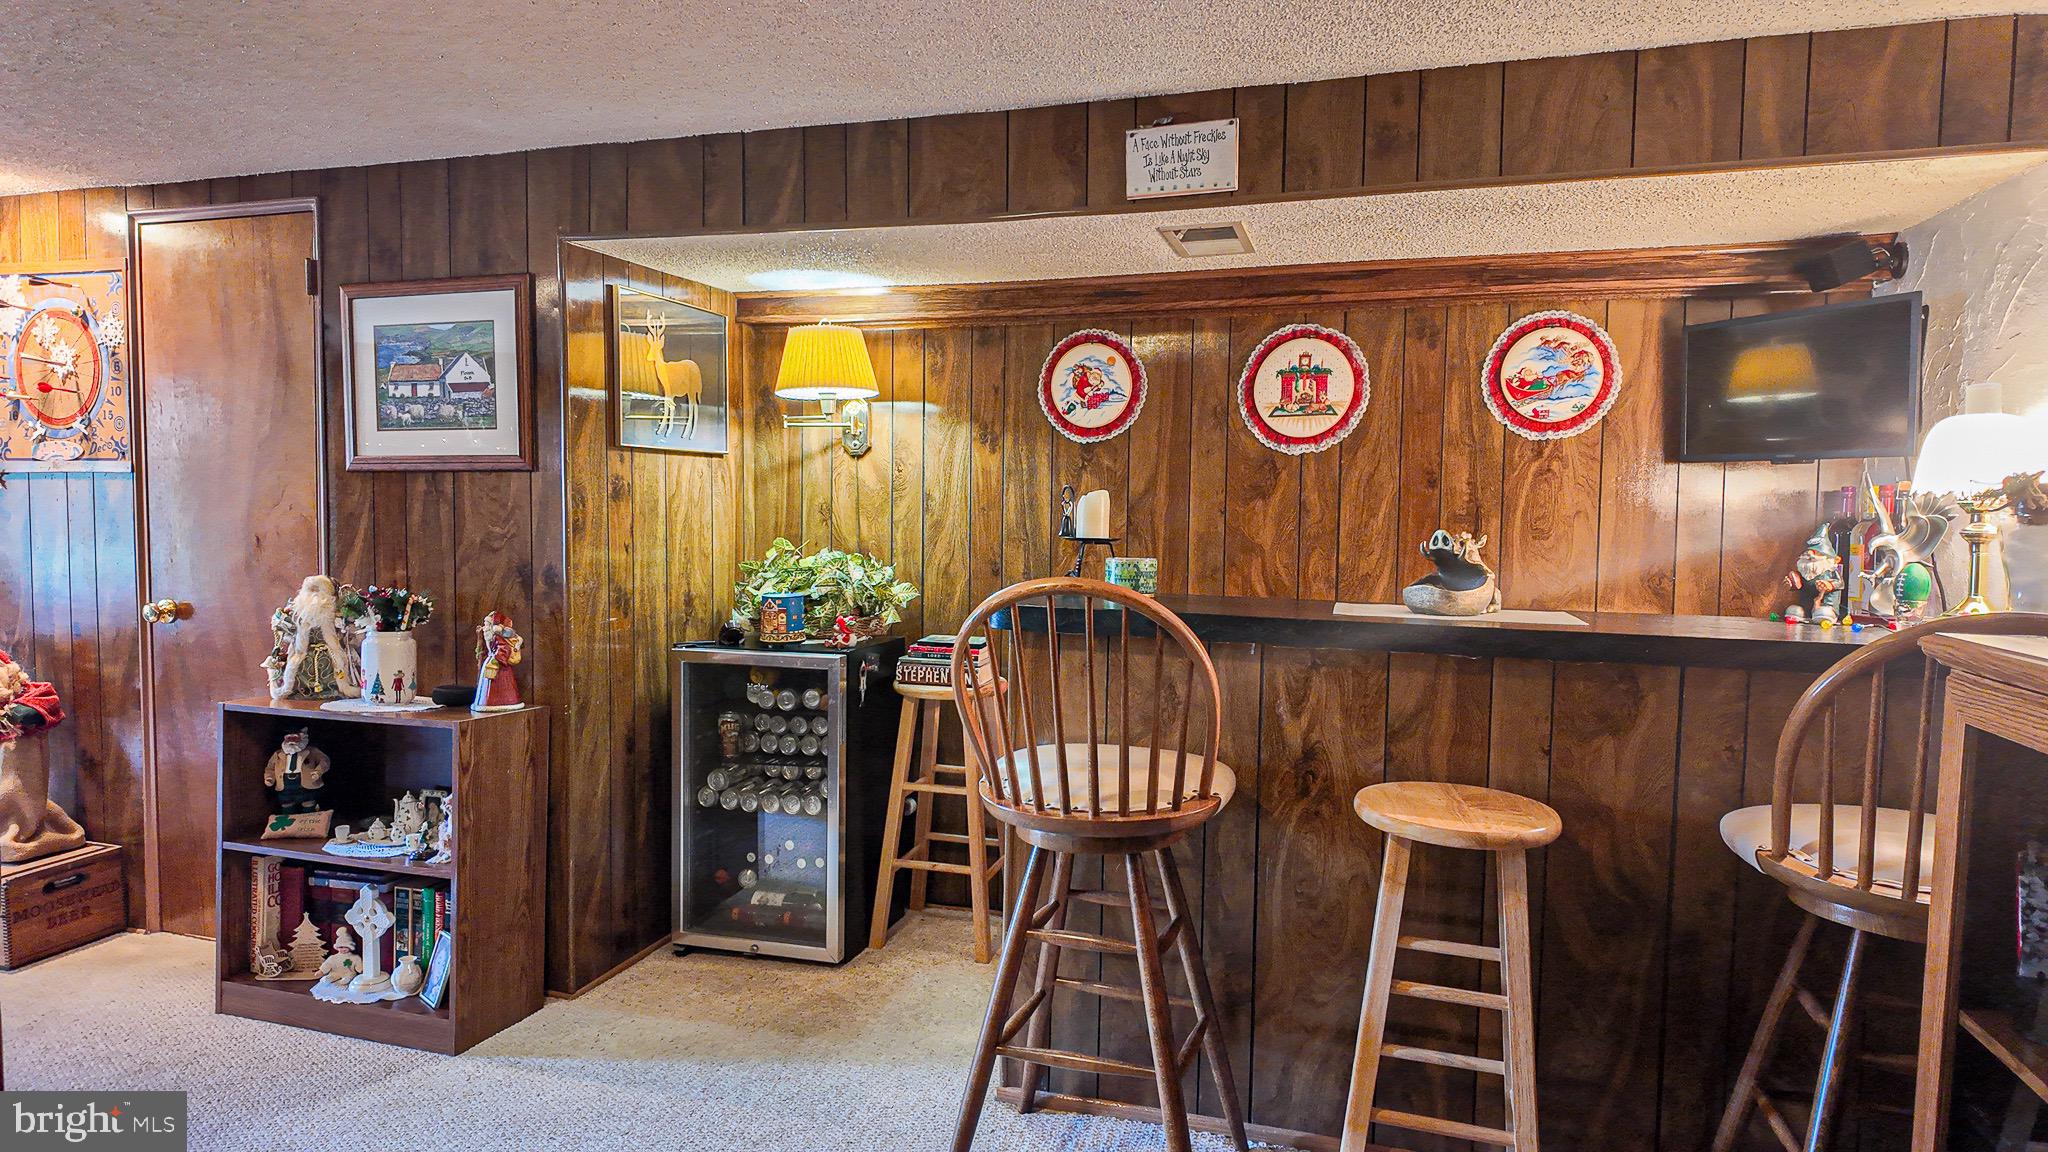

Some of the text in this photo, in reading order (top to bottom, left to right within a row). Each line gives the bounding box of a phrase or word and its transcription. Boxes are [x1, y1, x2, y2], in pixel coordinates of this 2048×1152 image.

[1133, 129, 1226, 152] A Face Without Freckles
[1143, 148, 1210, 168] Is Like A Night Sky
[1148, 166, 1202, 183] Without Stars
[896, 669, 948, 684] STEPHEN
